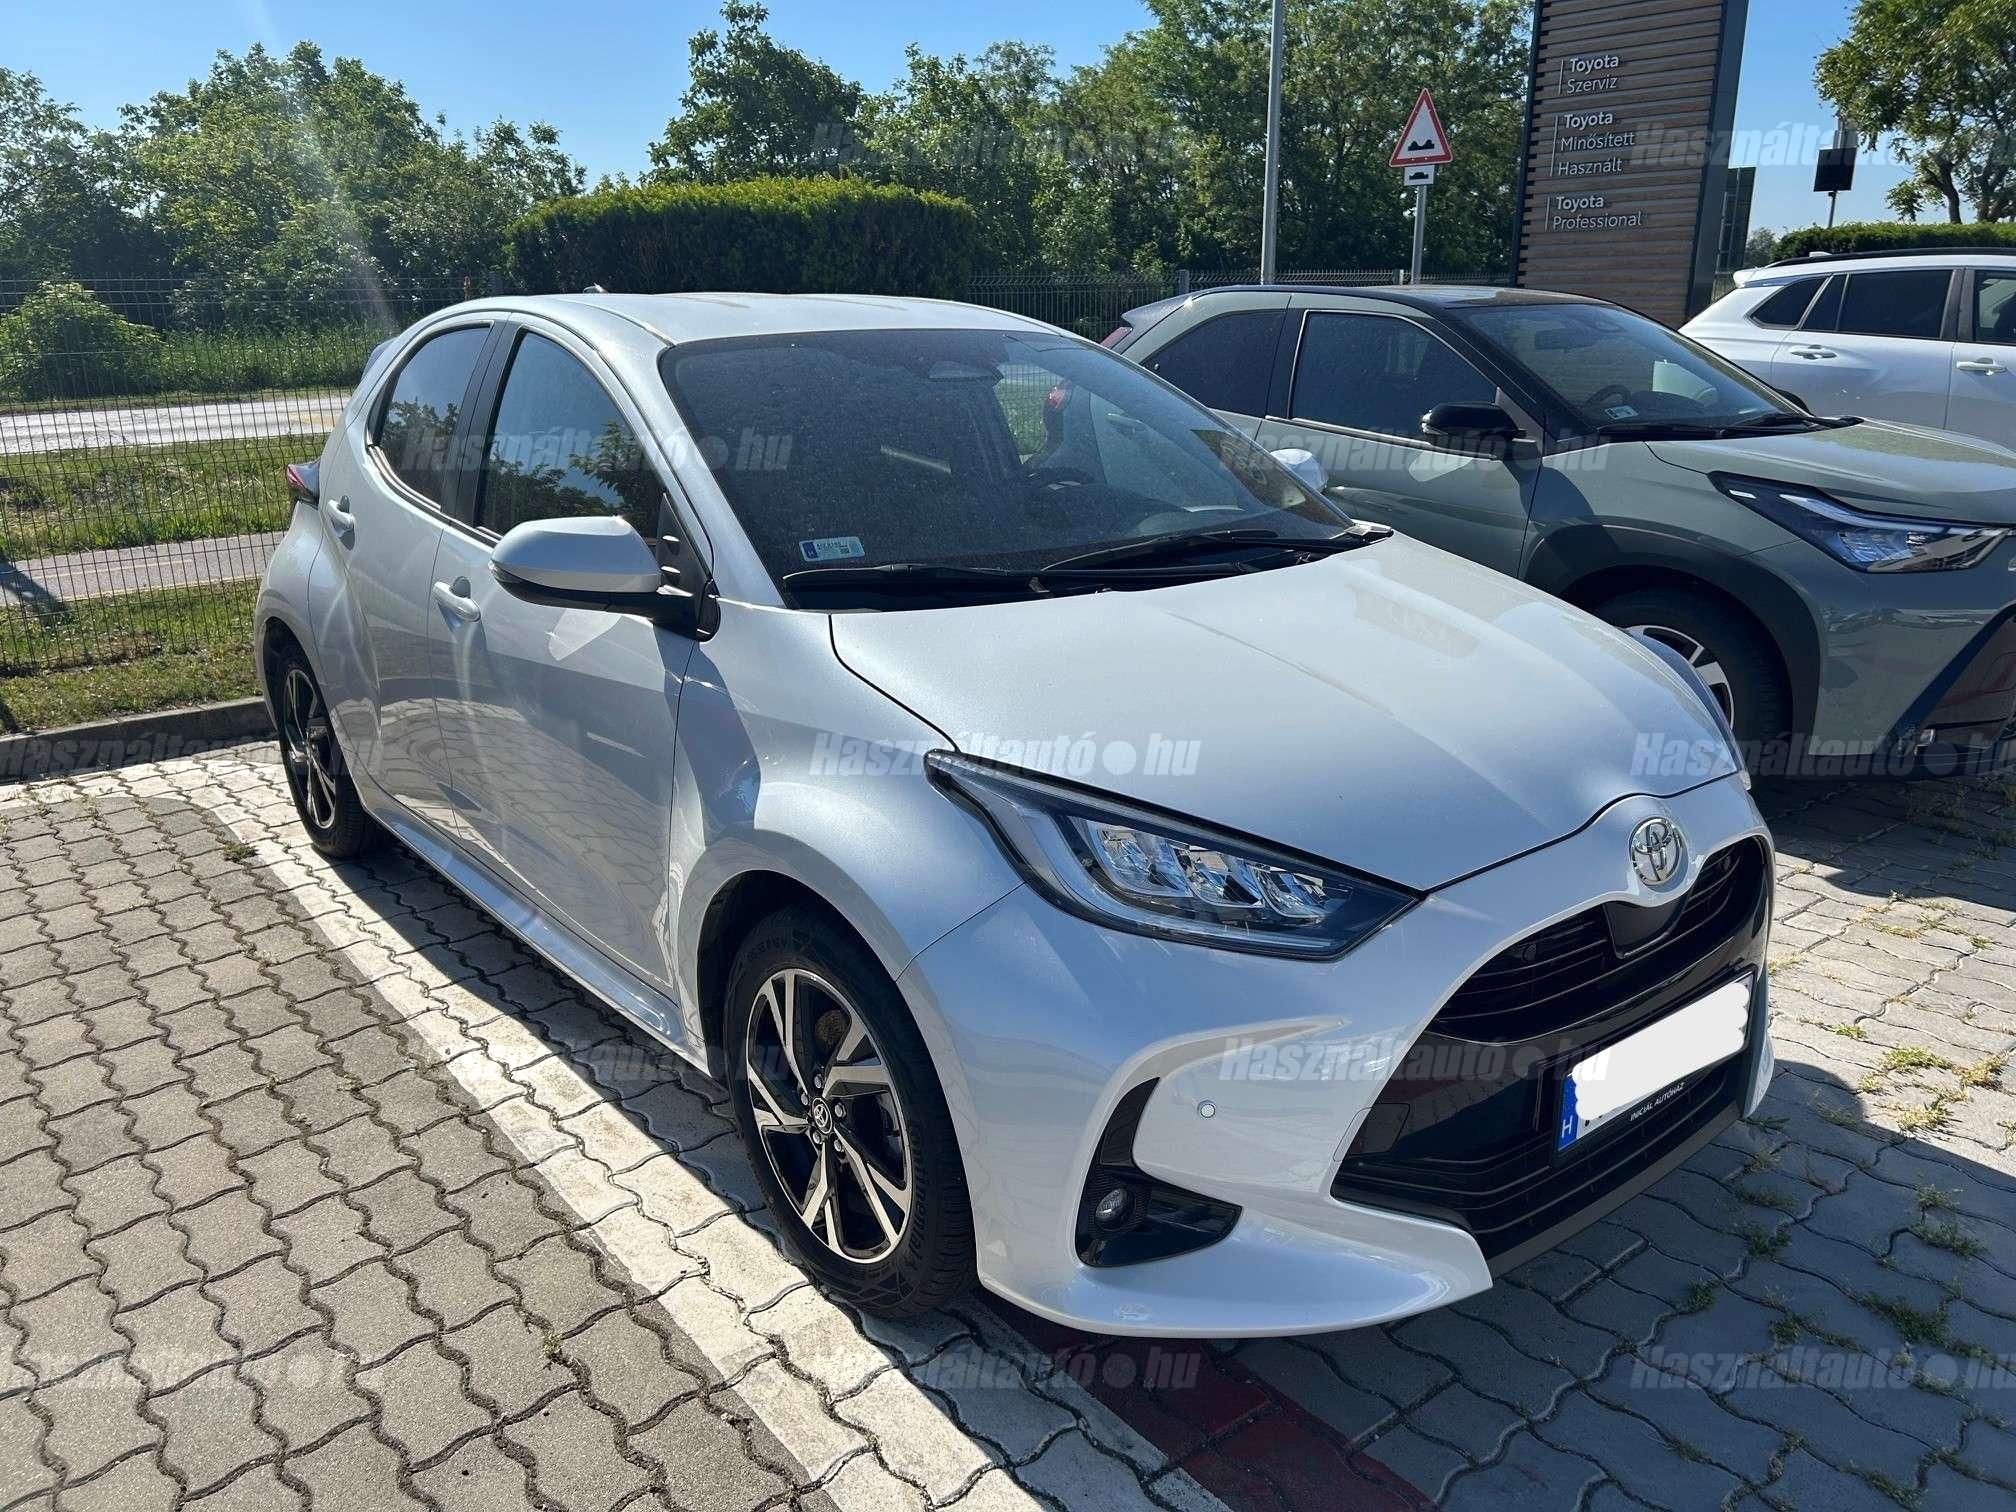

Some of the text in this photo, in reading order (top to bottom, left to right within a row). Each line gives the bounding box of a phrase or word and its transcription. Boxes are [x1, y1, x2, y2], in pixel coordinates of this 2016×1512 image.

[1570, 55, 1619, 74] Toyota
[1567, 74, 1618, 93] Szerviz
[1564, 112, 1613, 130] Toyota
[1560, 132, 1635, 151] Minősített
[1558, 157, 1622, 176] Használt
[1556, 195, 1604, 213] Toyota
[1553, 211, 1642, 229] Professional
[1561, 1115, 1573, 1139] H
